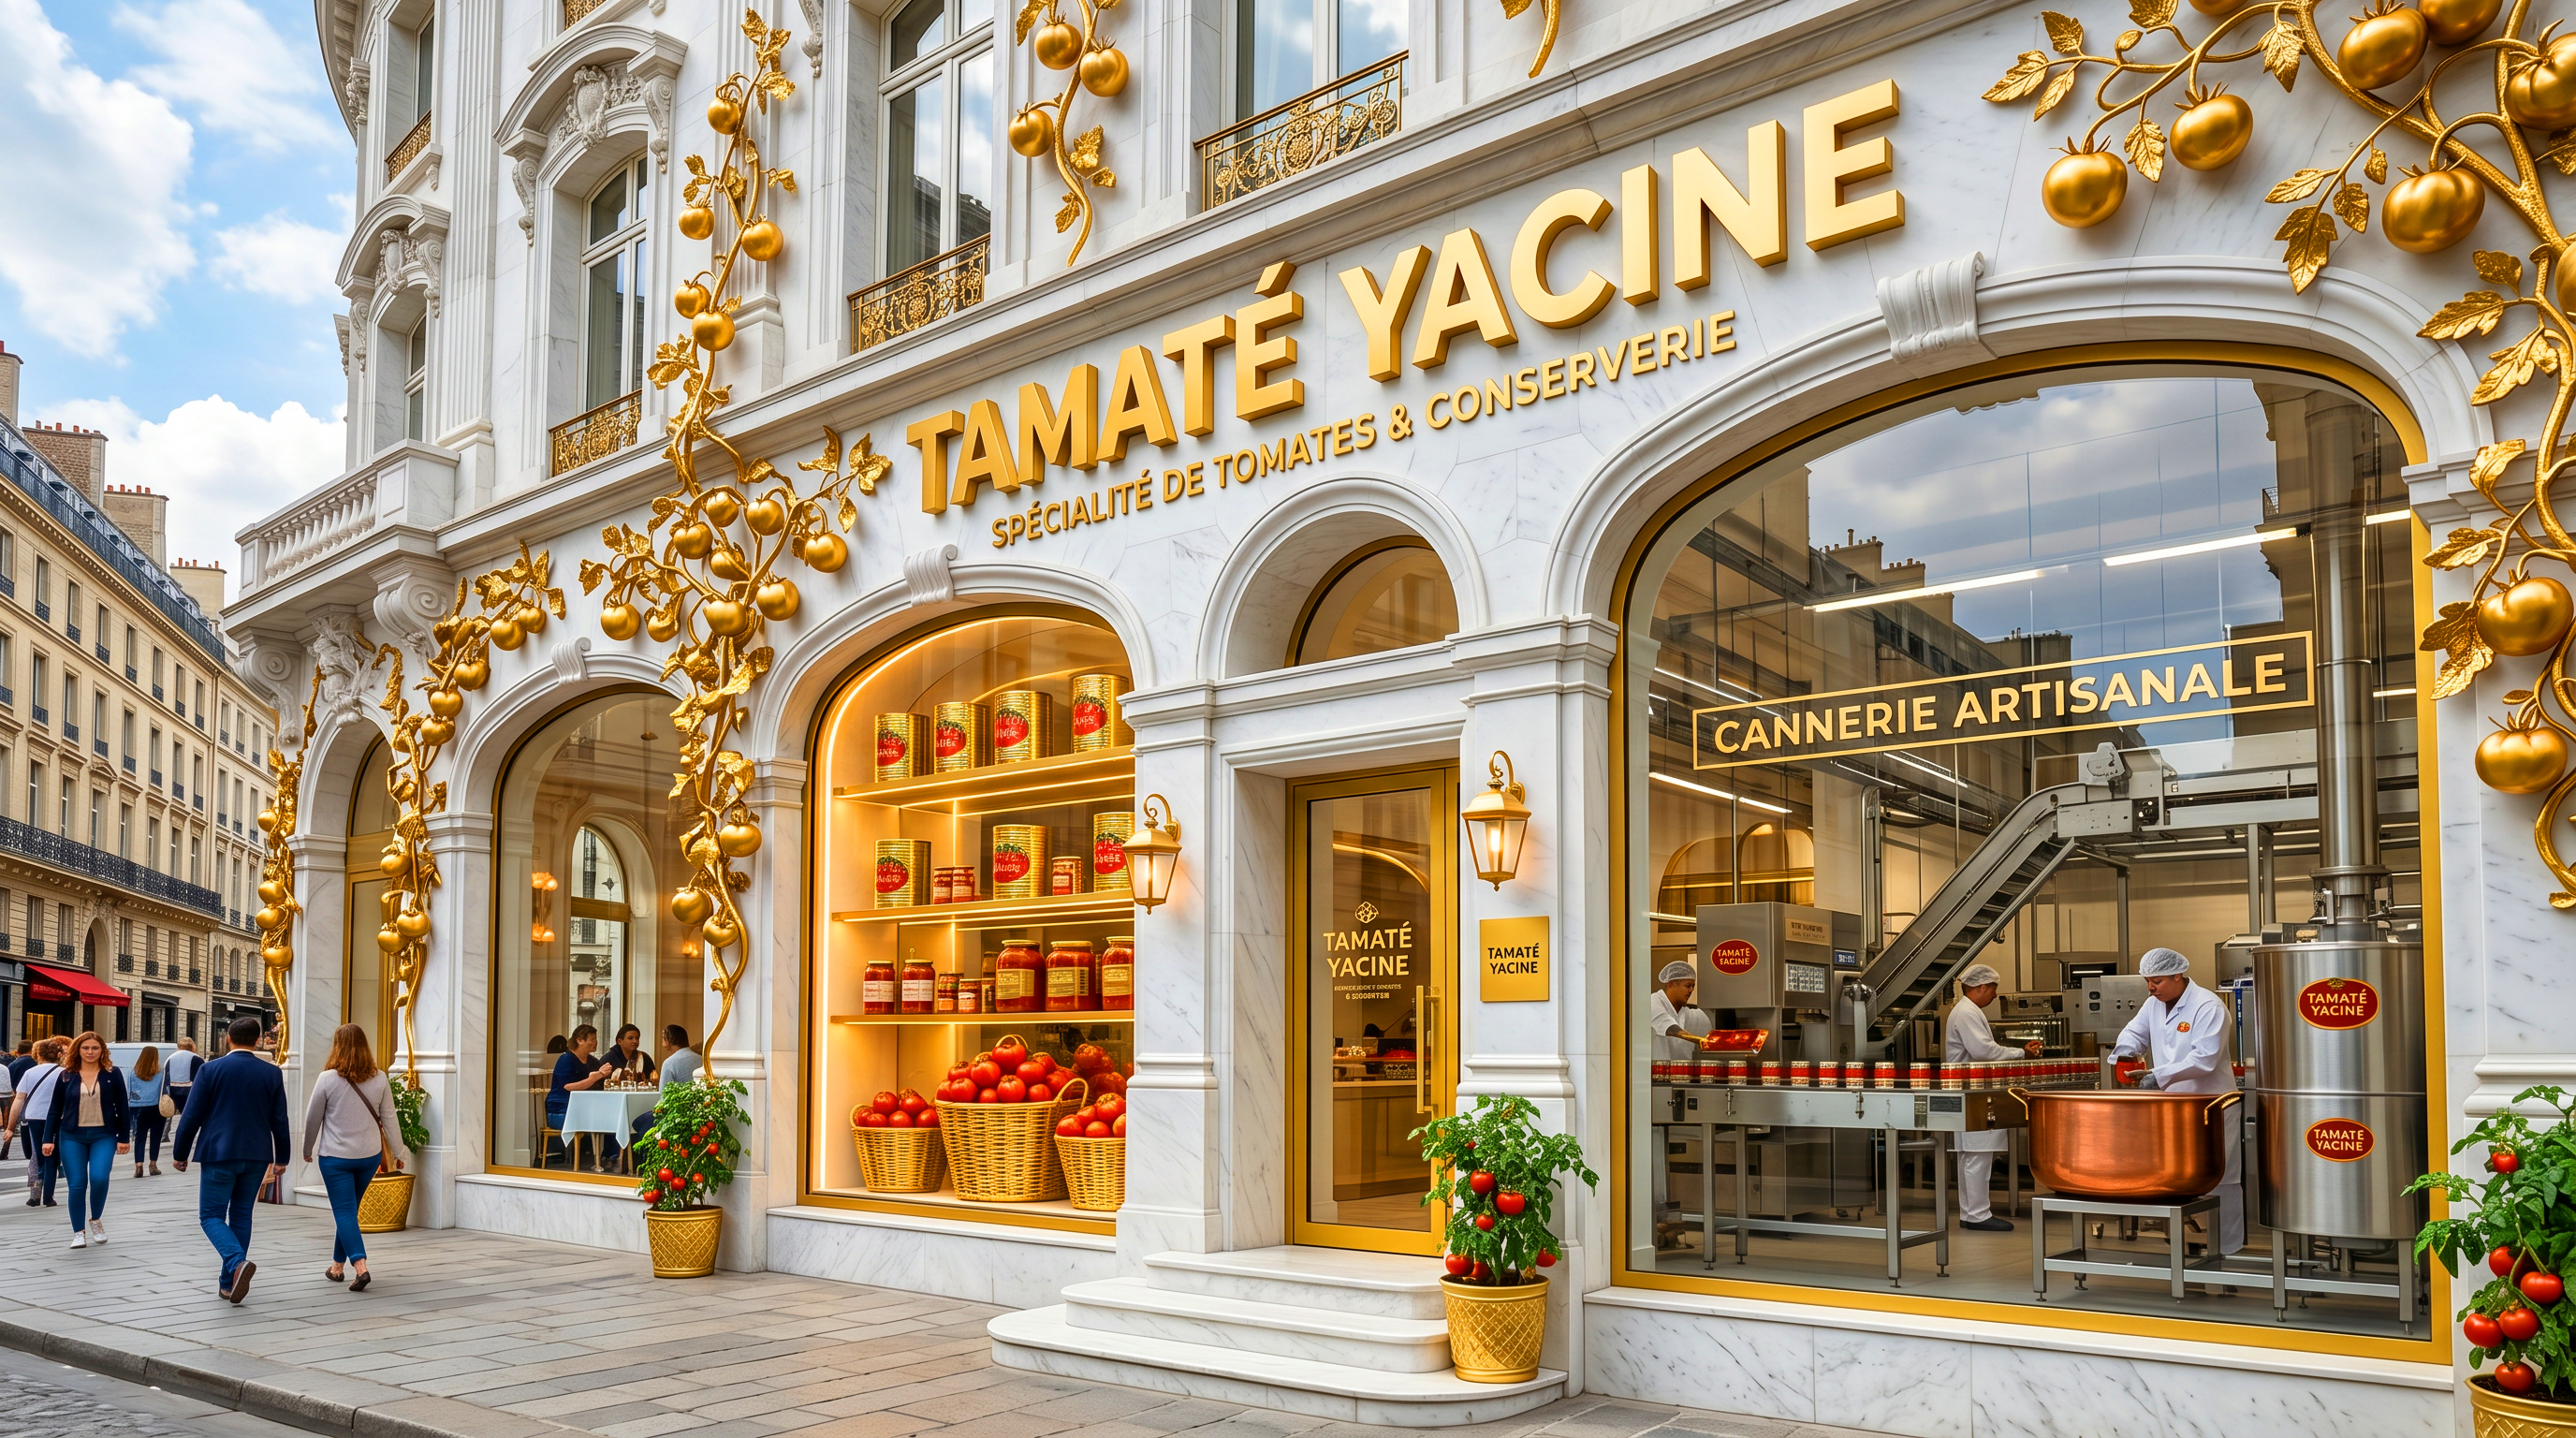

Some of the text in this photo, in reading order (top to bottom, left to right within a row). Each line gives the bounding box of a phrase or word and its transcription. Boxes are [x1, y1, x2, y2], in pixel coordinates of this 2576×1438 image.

[906, 78, 1905, 515] TAMATÉ YACINE
[991, 310, 1736, 549] SPÉCIALITÉ DE TOMATES & CONSERVERIE
[1714, 653, 2287, 755] CANNERIE ARTISANALE
[1323, 921, 1412, 950] TAMATÉ
[1487, 943, 1540, 960] TAMATÉ
[1326, 955, 1410, 977] YACINE
[1489, 961, 1539, 975] YACINE
[2307, 989, 2367, 1004] TAMATÉ
[2311, 1005, 2364, 1016] YACINE
[2316, 1140, 2364, 1152] YACINE
